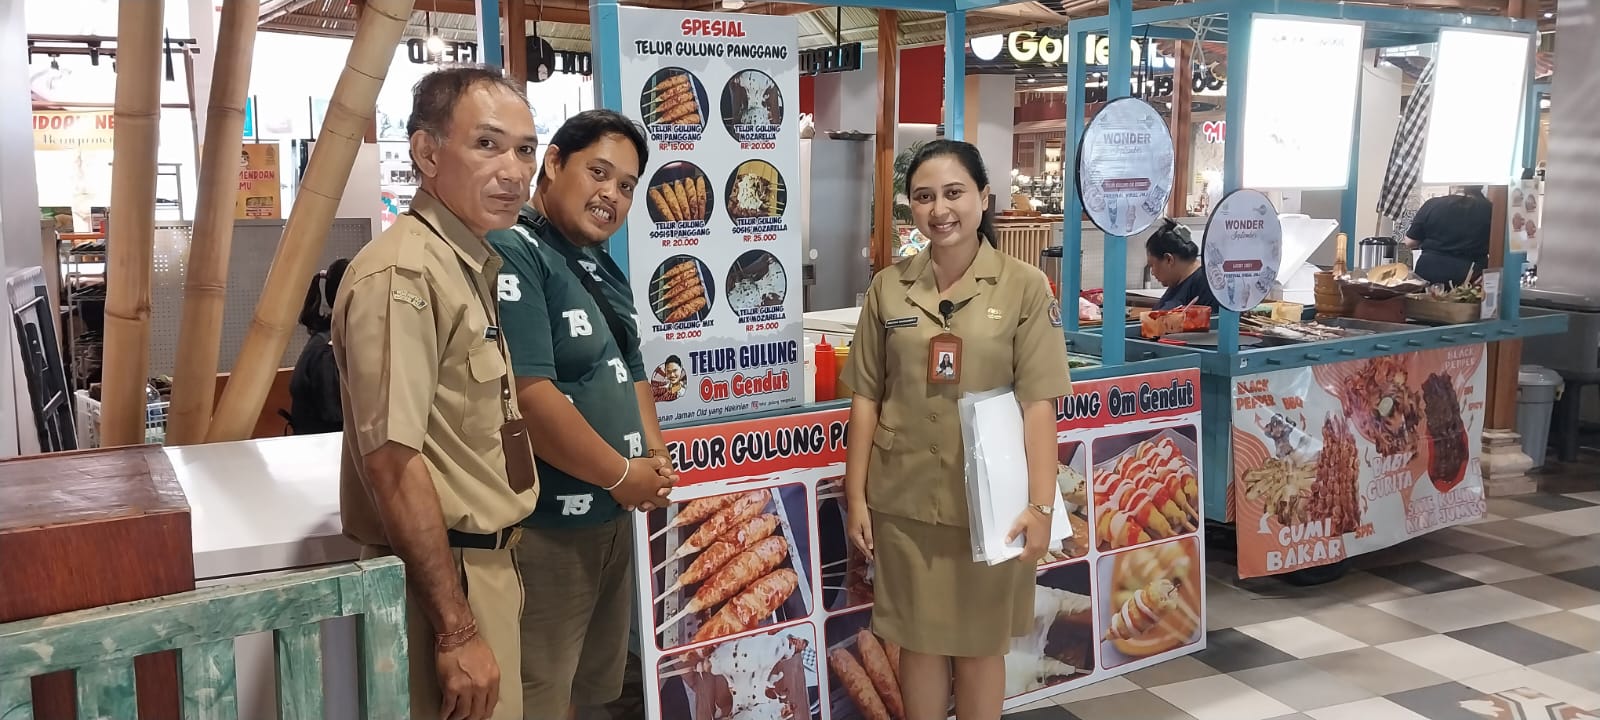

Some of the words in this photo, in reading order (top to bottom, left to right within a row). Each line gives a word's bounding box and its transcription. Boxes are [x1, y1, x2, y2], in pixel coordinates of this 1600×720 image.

[681, 19, 745, 37] SPESIAL
[635, 40, 673, 56] TELUR
[675, 42, 724, 58] GULUNG
[727, 43, 787, 60] PANGGANG
[1103, 132, 1151, 145] WONDER
[656, 222, 676, 230] TELUR
[678, 220, 704, 228] GULUNG
[732, 226, 750, 234] SOSIS
[753, 224, 787, 232] MOZARELLA
[1225, 219, 1264, 230] WONDER
[650, 230, 670, 238] SOSIS
[674, 228, 710, 238] PANGGANG
[673, 238, 698, 246] 20.000
[740, 308, 758, 316] TELUR
[760, 306, 784, 314] GULUNG
[652, 324, 672, 332] TELUR
[674, 321, 700, 330] GULUNG
[703, 319, 714, 327] MIX
[756, 322, 779, 331] 25.000
[676, 330, 701, 339] 20.000
[689, 348, 735, 375] TELUR
[740, 340, 797, 368] GULUNG
[700, 376, 729, 401] Om
[732, 370, 789, 397] Gendut
[1108, 386, 1136, 417] Om
[1139, 378, 1194, 413] Gendut
[675, 411, 695, 420] Jaman
[708, 406, 723, 416] yang
[731, 424, 825, 464] GULUNG
[1373, 451, 1413, 477] BABY
[1367, 470, 1413, 501] GURITA
[1440, 500, 1487, 523] JUMBO
[1278, 517, 1331, 546] CUMI
[1266, 539, 1341, 572] BAKAR
